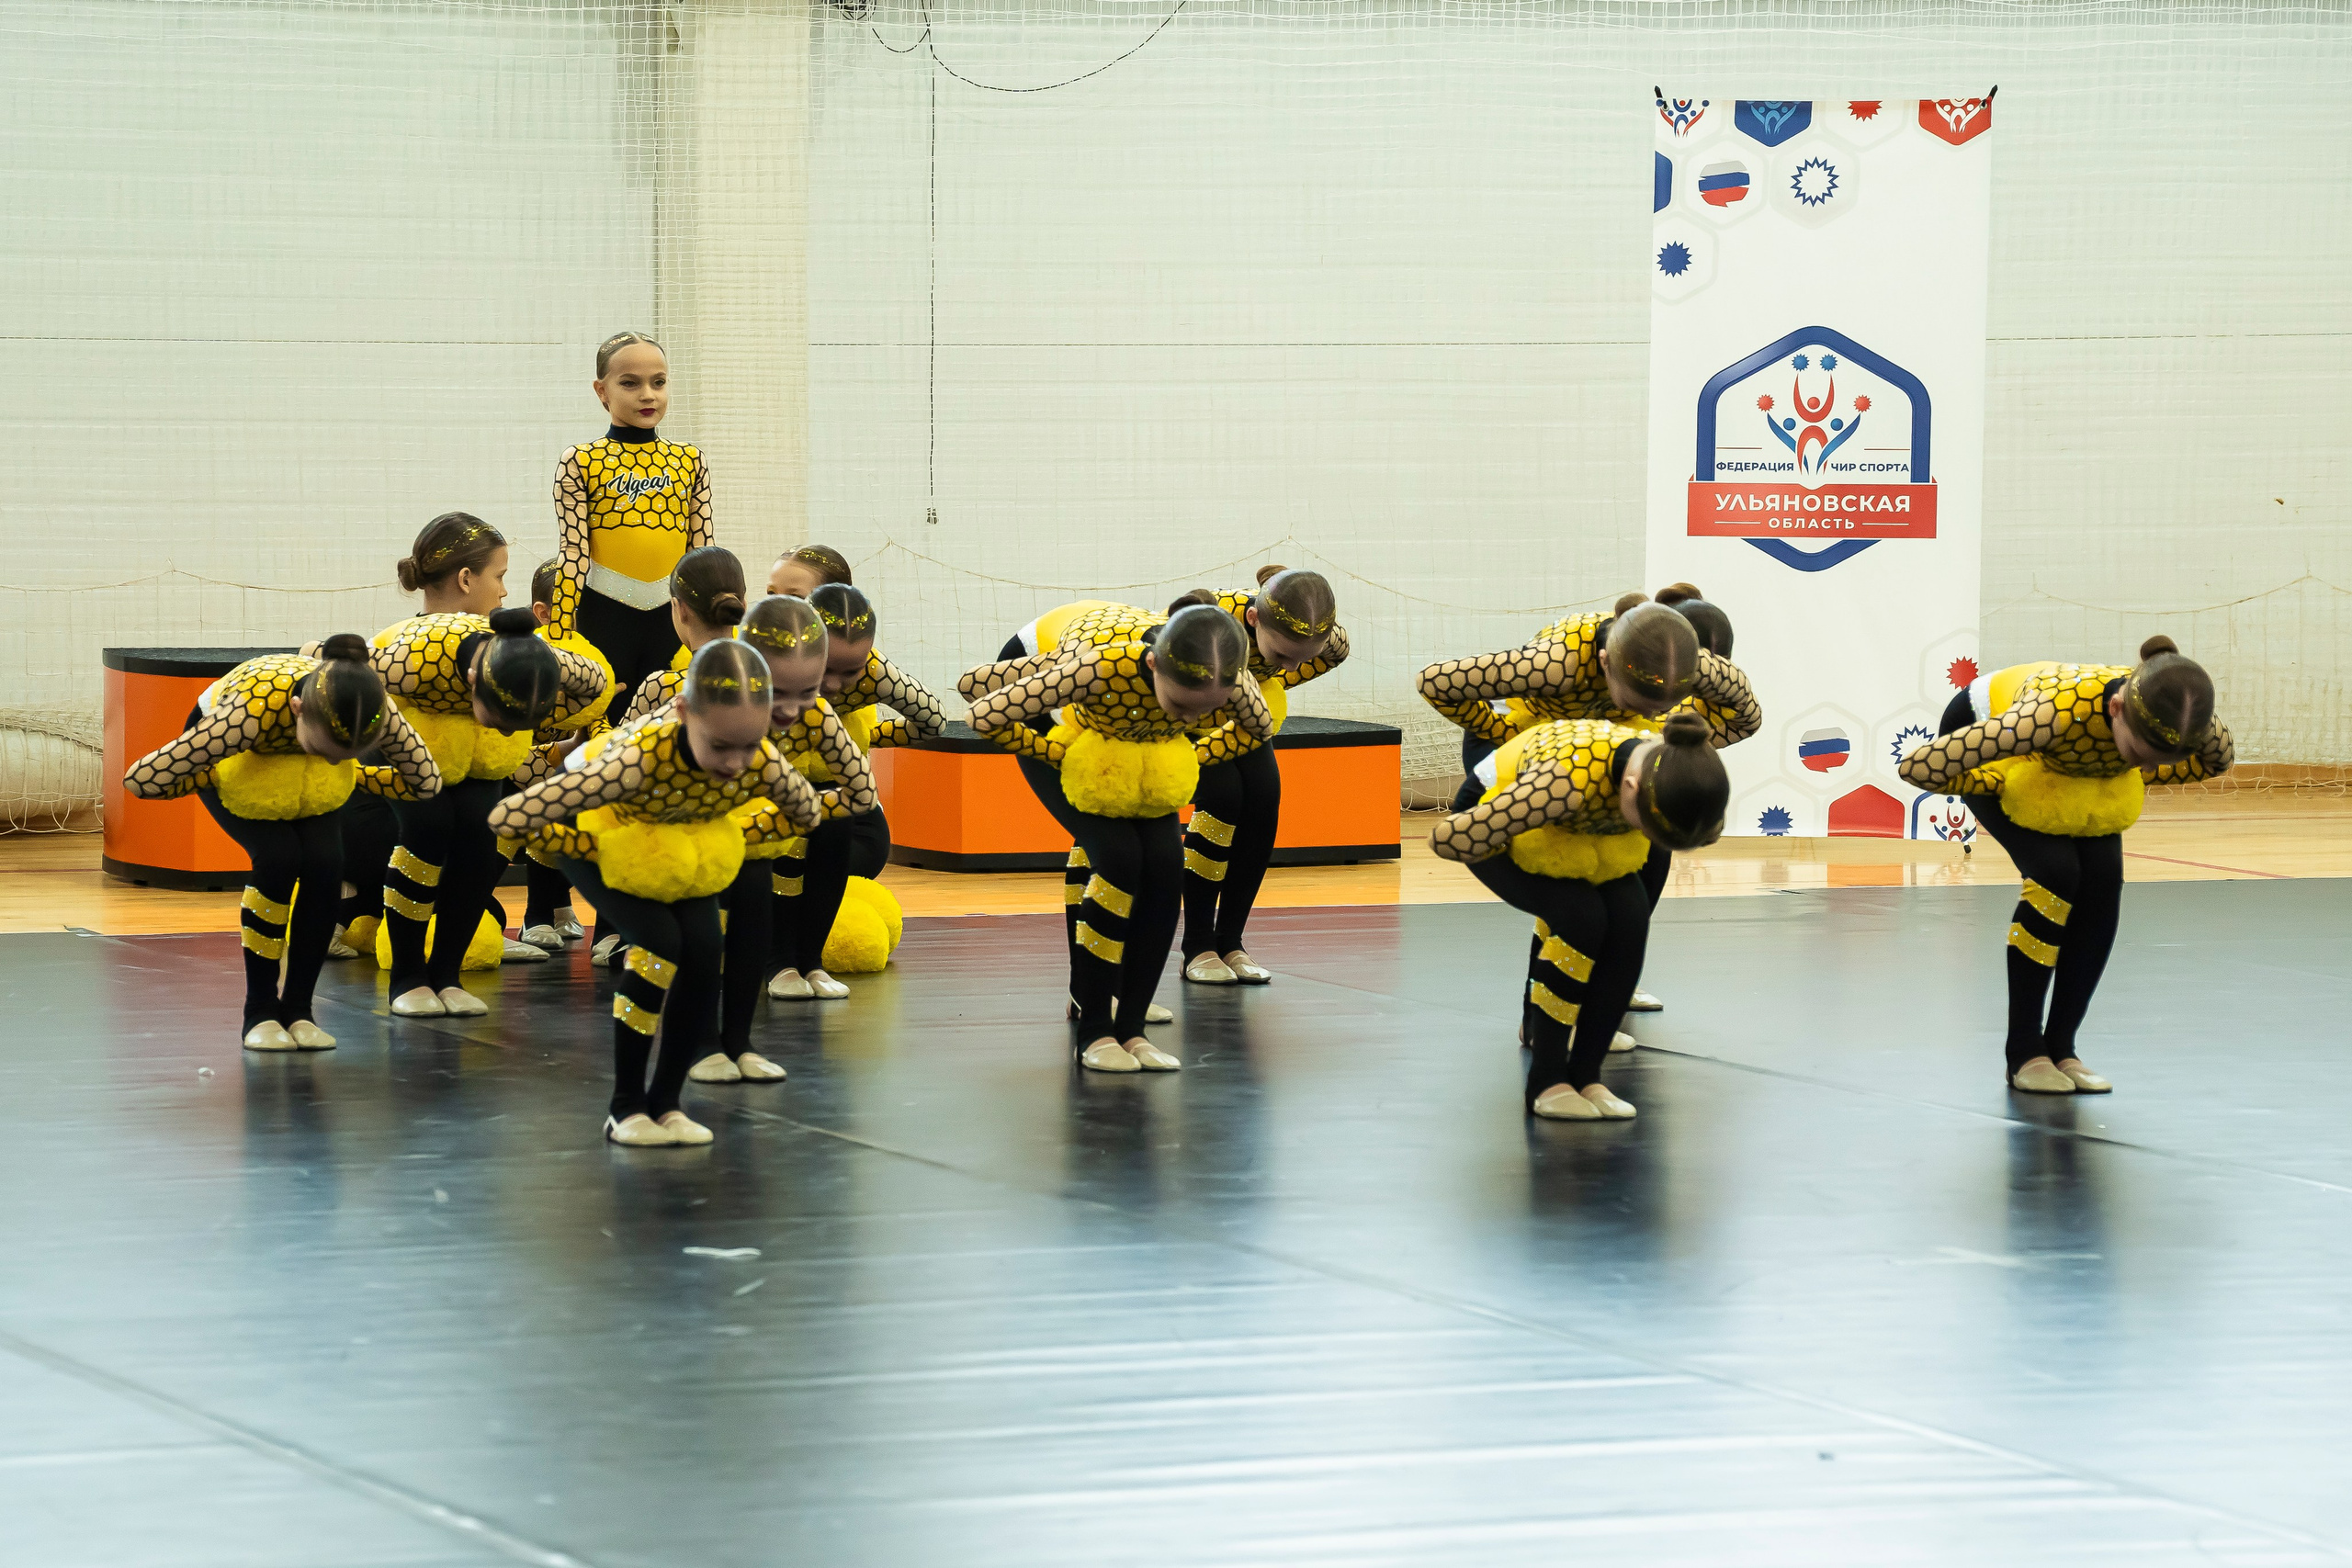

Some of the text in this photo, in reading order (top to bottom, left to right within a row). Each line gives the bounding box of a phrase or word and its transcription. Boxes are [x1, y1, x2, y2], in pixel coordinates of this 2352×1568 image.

[1716, 461, 1910, 473] ФЕДЕРАЦИЯ ЧИР СПОРТА
[607, 472, 671, 503] Идеал
[1714, 493, 1911, 513] УЛЬЯНОВСКАЯ
[1768, 517, 1855, 529] ОБЛАСТЬ
